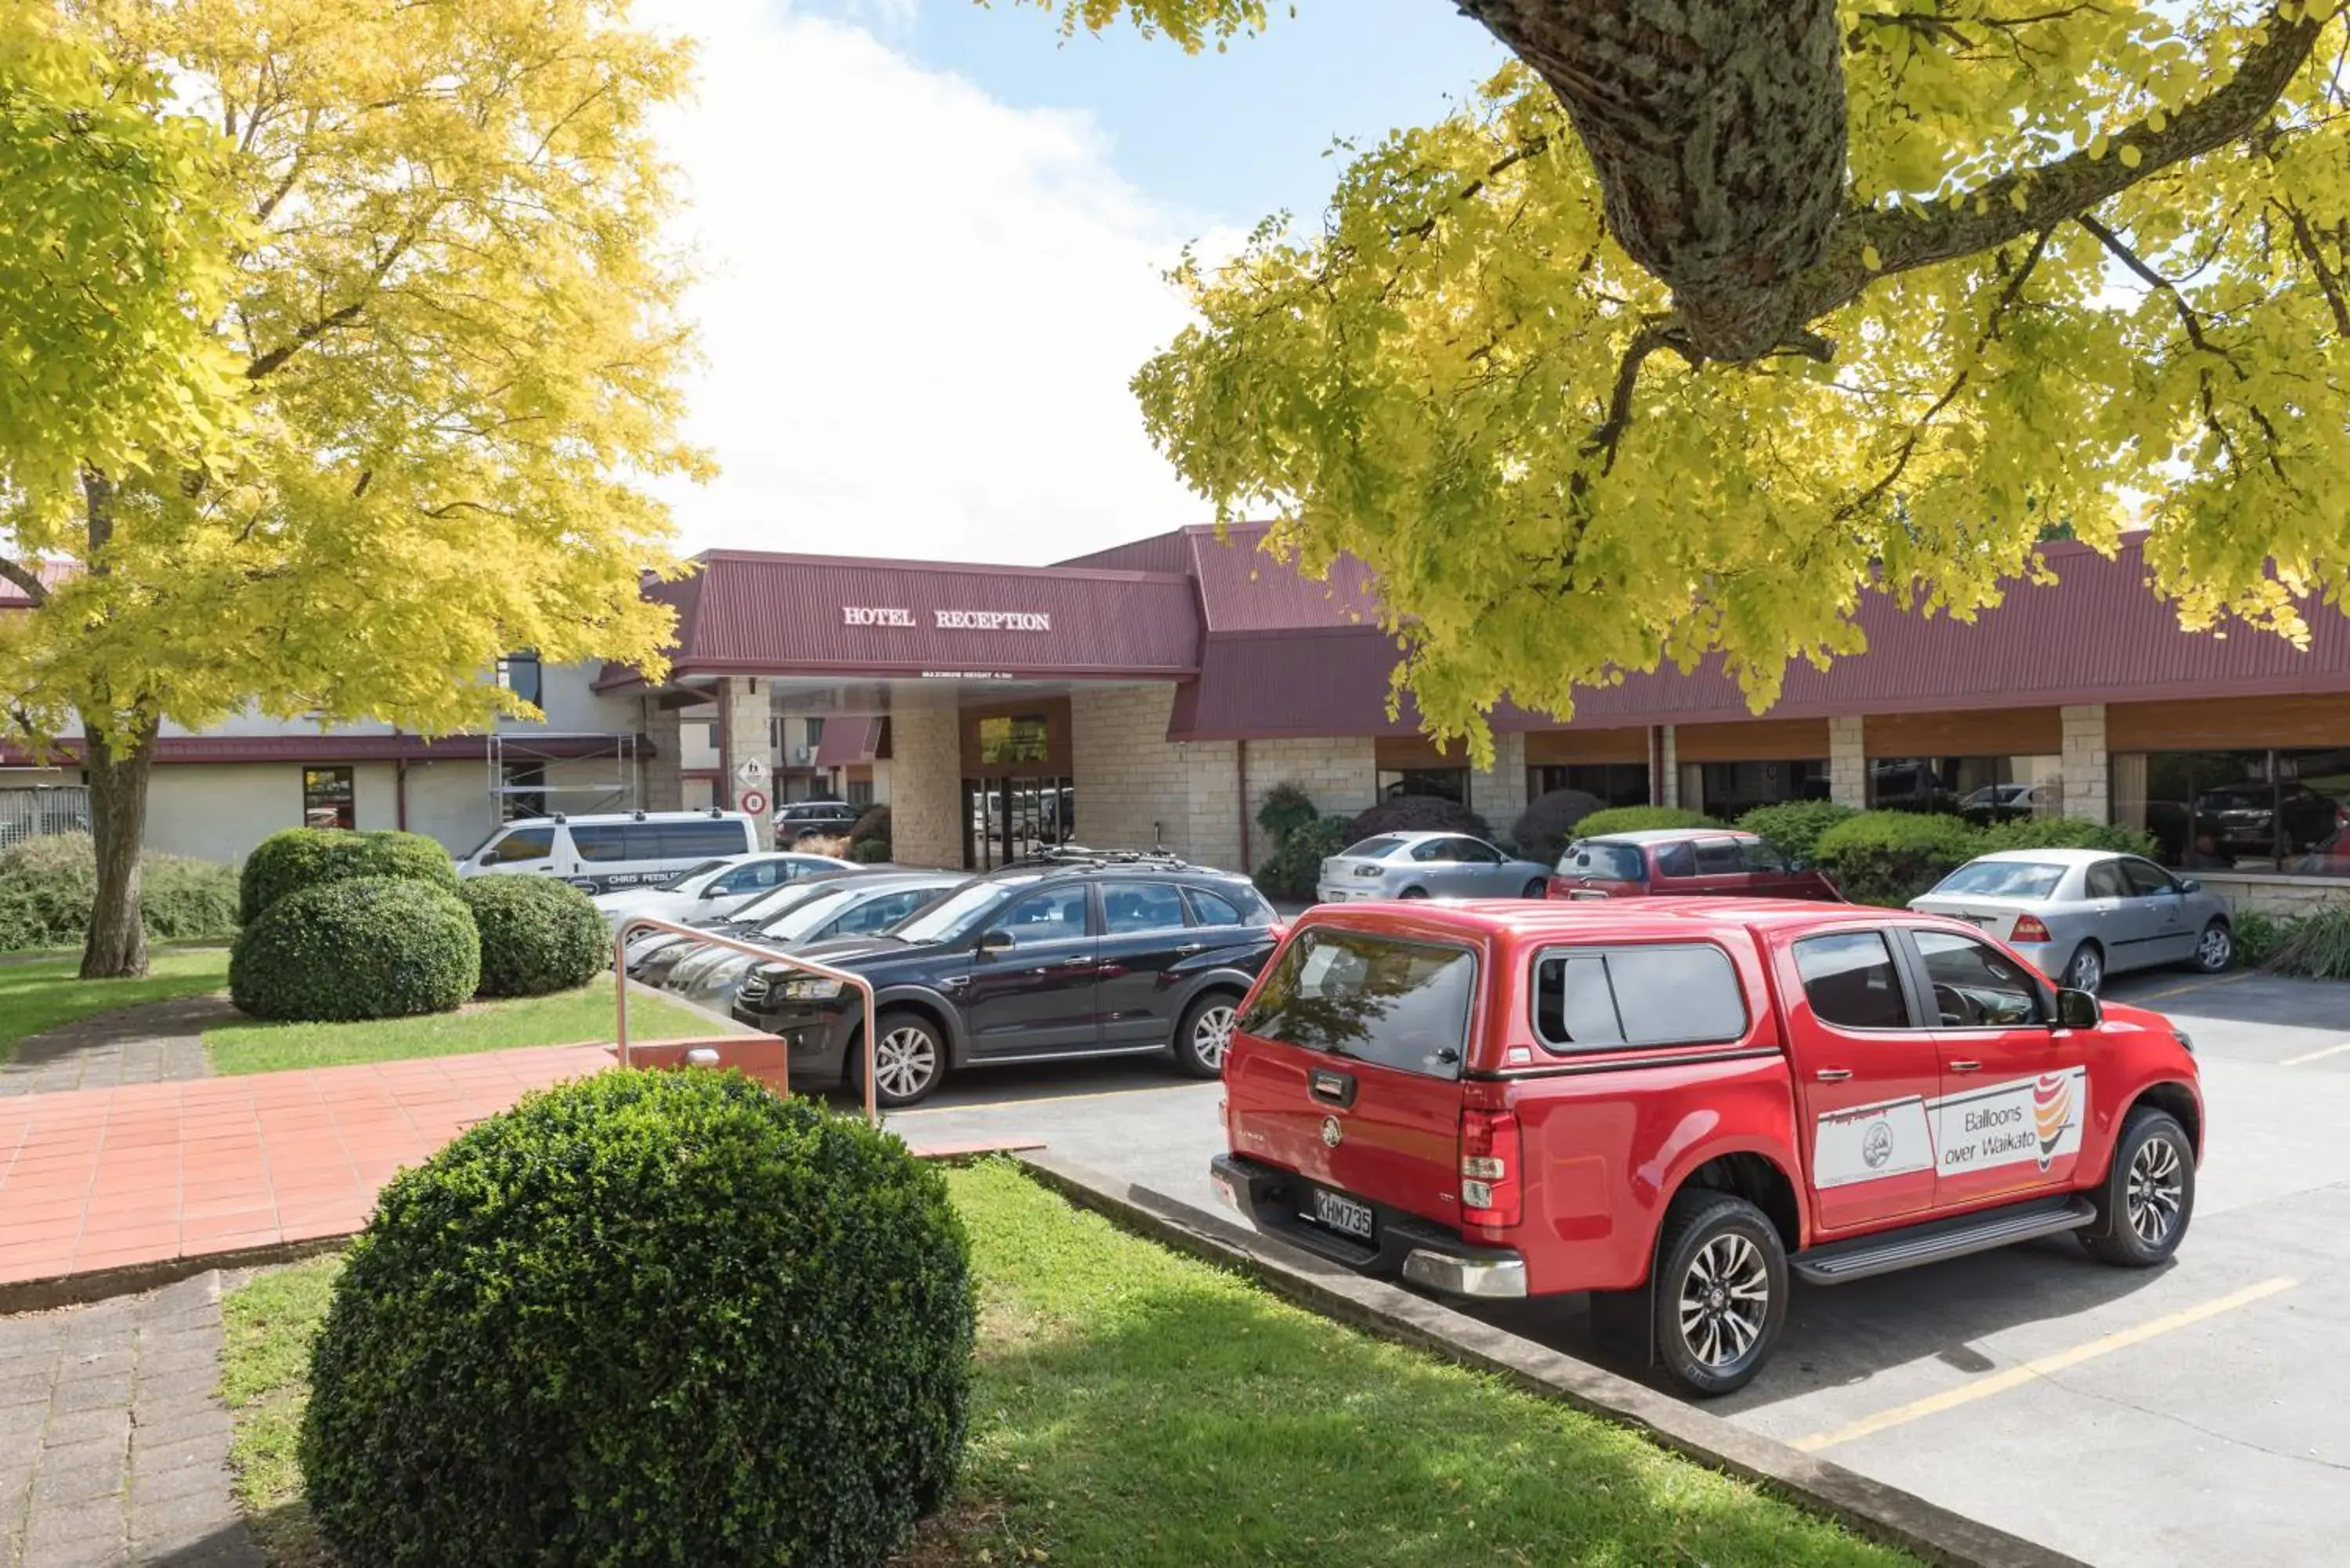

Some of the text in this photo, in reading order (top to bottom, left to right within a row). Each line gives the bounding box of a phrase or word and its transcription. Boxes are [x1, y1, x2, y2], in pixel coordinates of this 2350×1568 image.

[842, 607, 1050, 630] HOTEL RECEPTION
[609, 874, 638, 884] CHRIS
[1965, 1106, 2023, 1132] Balloons
[1944, 1131, 2036, 1165] over Waikato
[1317, 1195, 1371, 1235] KHM735
